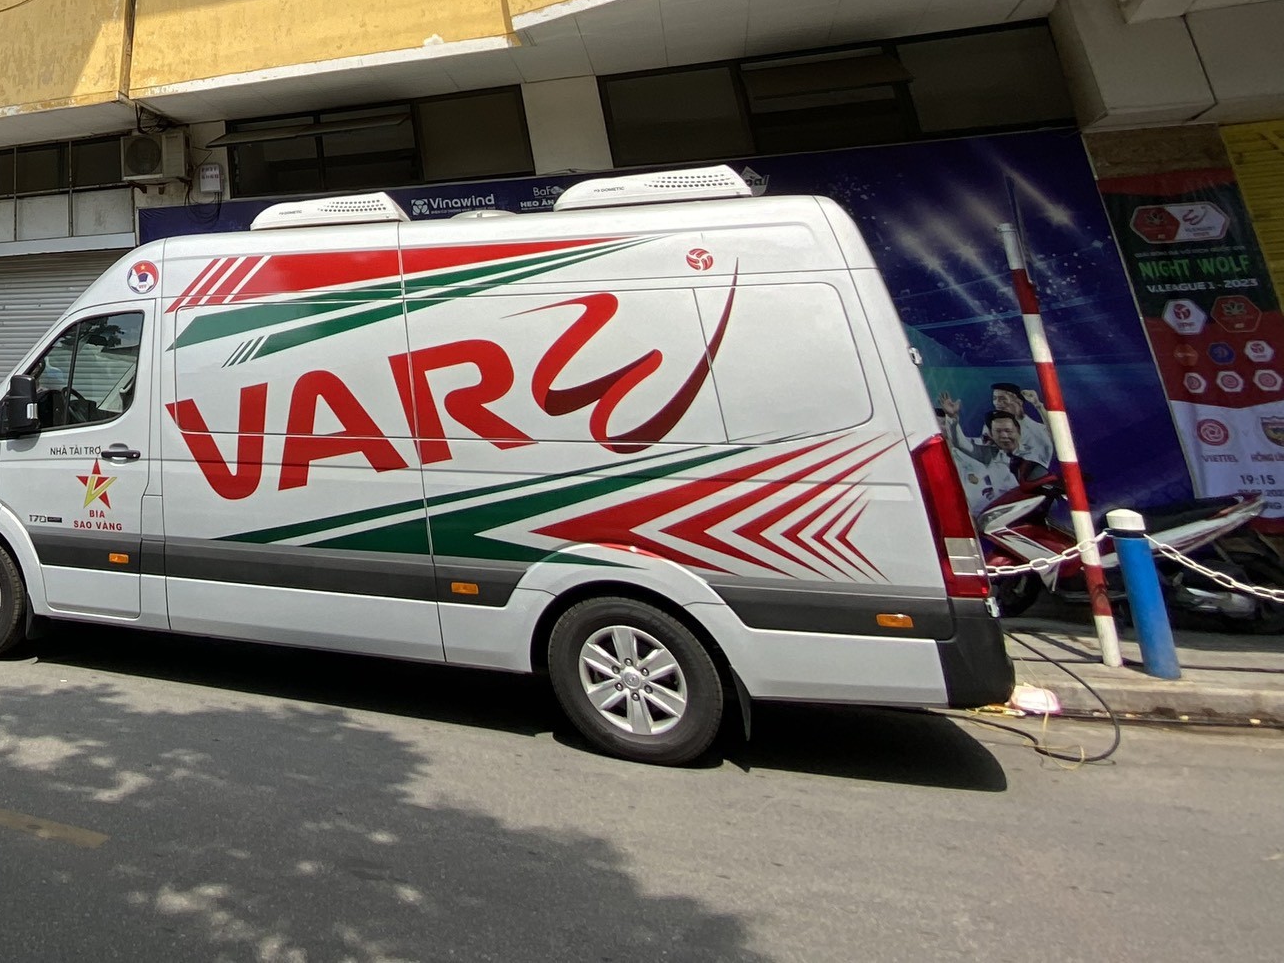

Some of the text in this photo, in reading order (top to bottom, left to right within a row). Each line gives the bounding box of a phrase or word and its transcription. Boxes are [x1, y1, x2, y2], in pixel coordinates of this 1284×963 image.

[429, 193, 495, 209] Vinawind
[520, 200, 539, 208] HEO
[1137, 255, 1252, 279] NIGHT WOLF
[1146, 280, 1208, 293] V.LEAGUE
[1223, 278, 1259, 289] 2023
[50, 445, 67, 455] NHÀ
[70, 445, 82, 455] TÀI
[1201, 454, 1239, 463] VIETTEL
[1240, 474, 1276, 485] 19:15
[89, 509, 105, 518] BIA
[73, 520, 92, 529] SAO
[96, 521, 123, 531] VÀNG
